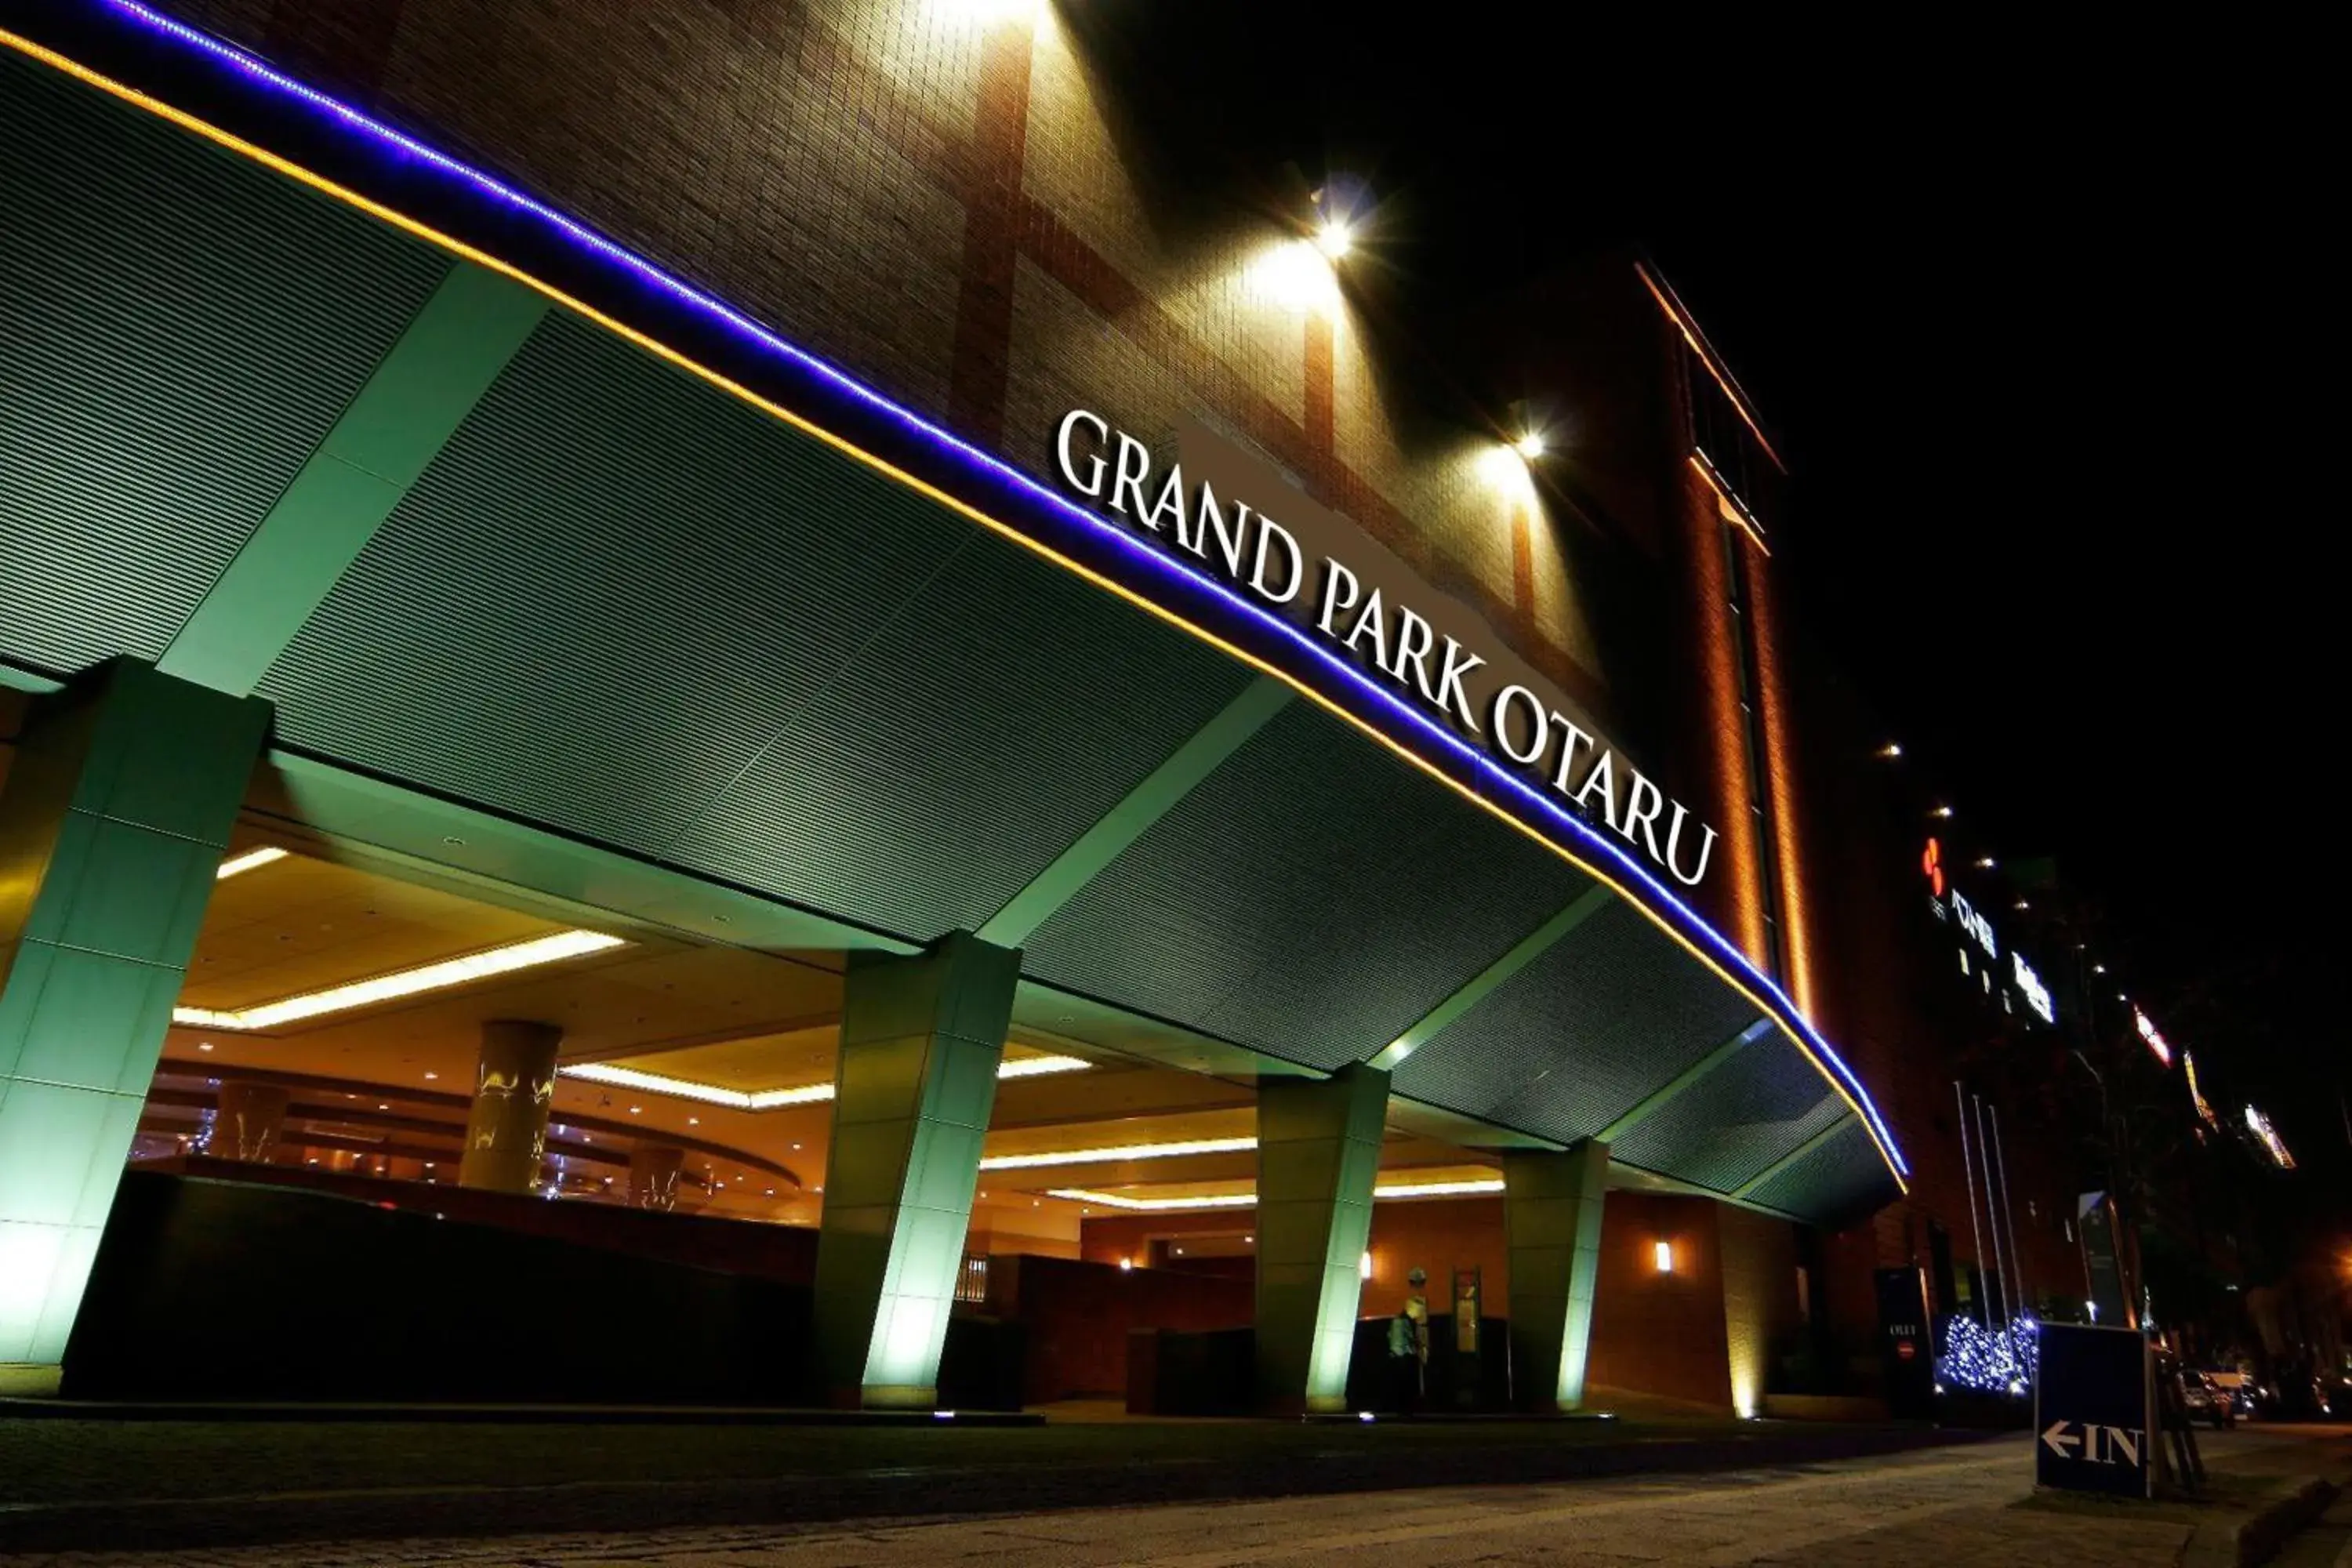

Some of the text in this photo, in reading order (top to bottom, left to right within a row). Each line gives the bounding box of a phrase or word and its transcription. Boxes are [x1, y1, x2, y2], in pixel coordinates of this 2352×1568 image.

[1058, 409, 1718, 886] GRAND PARK OTARU
[2082, 1424, 2144, 1467] IN
